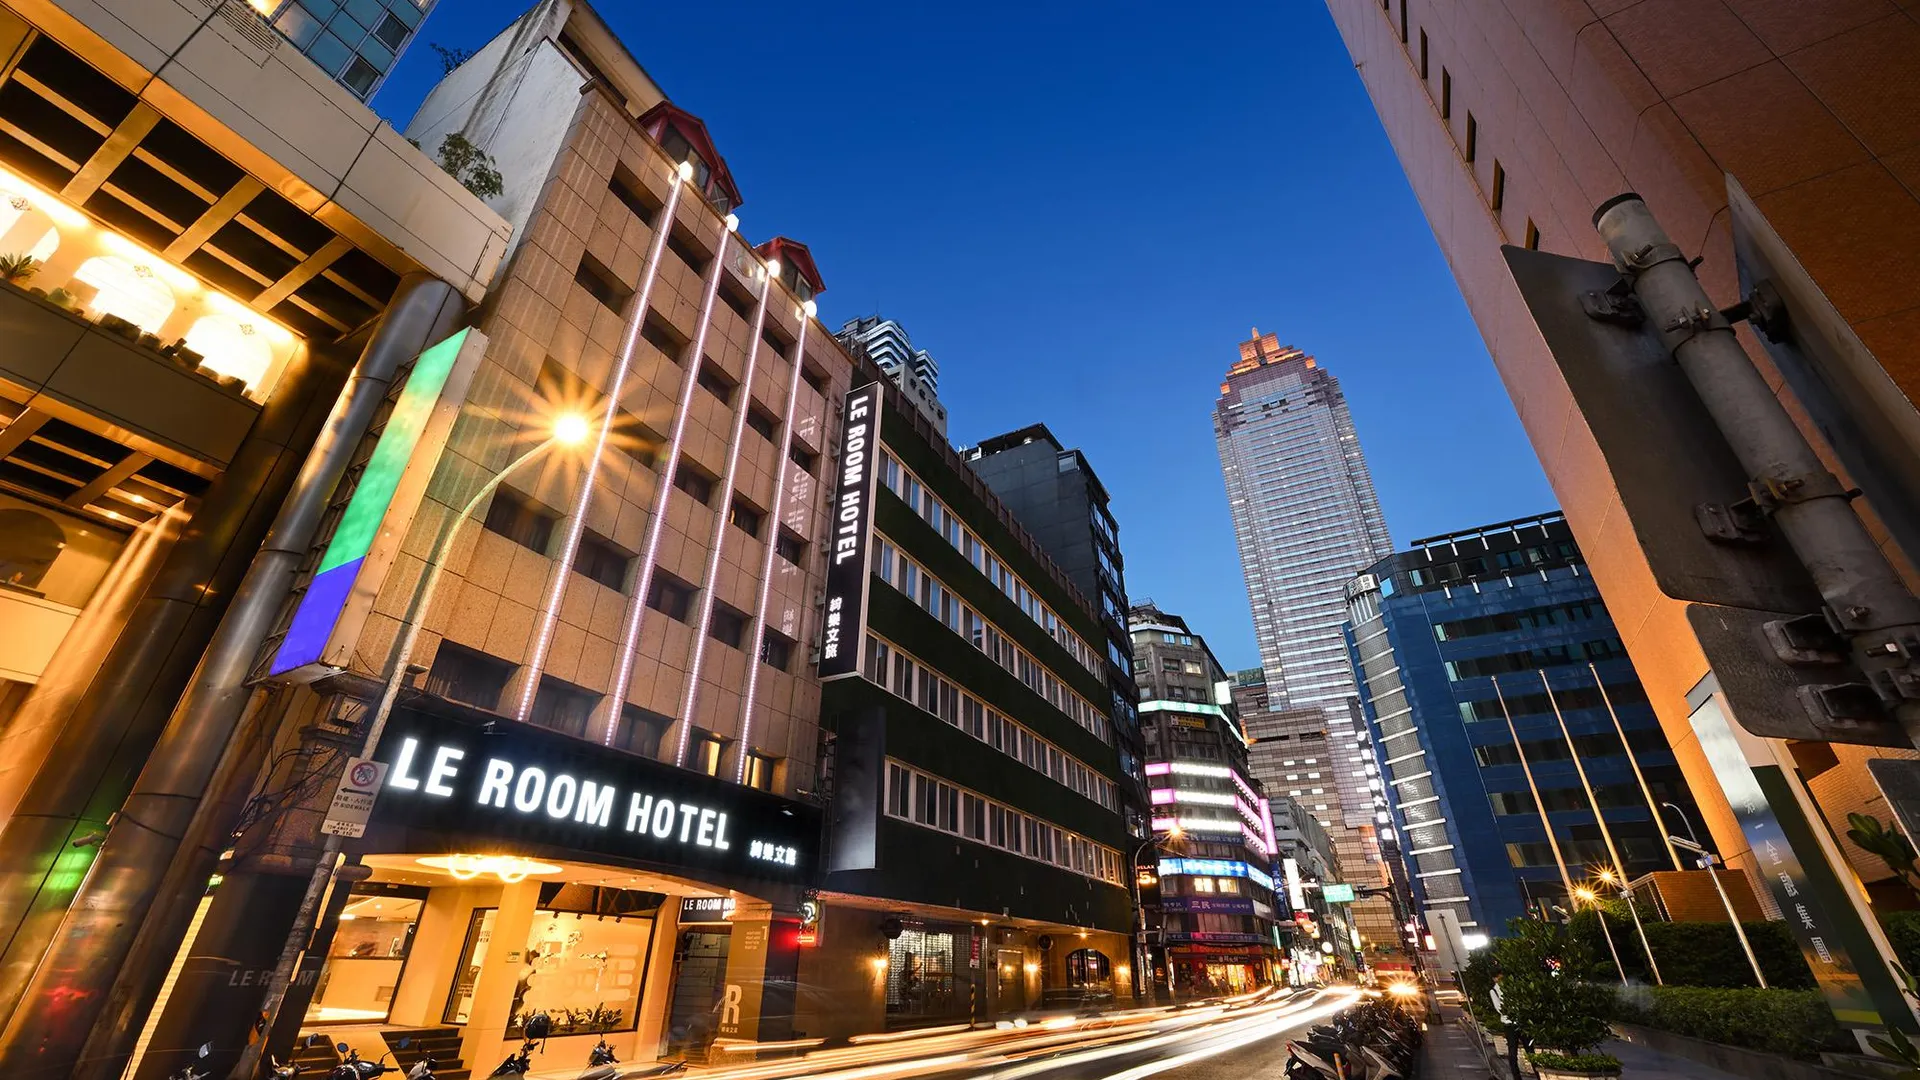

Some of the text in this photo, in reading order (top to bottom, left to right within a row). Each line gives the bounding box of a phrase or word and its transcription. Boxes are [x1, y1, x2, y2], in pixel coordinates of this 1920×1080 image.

[836, 395, 869, 565] LE ROOM HOTEL
[389, 737, 730, 850] LE ROOM HOTEL
[684, 899, 694, 910] LE
[696, 898, 722, 910] ROOM
[228, 970, 254, 986] LE
[722, 984, 742, 1025] R
